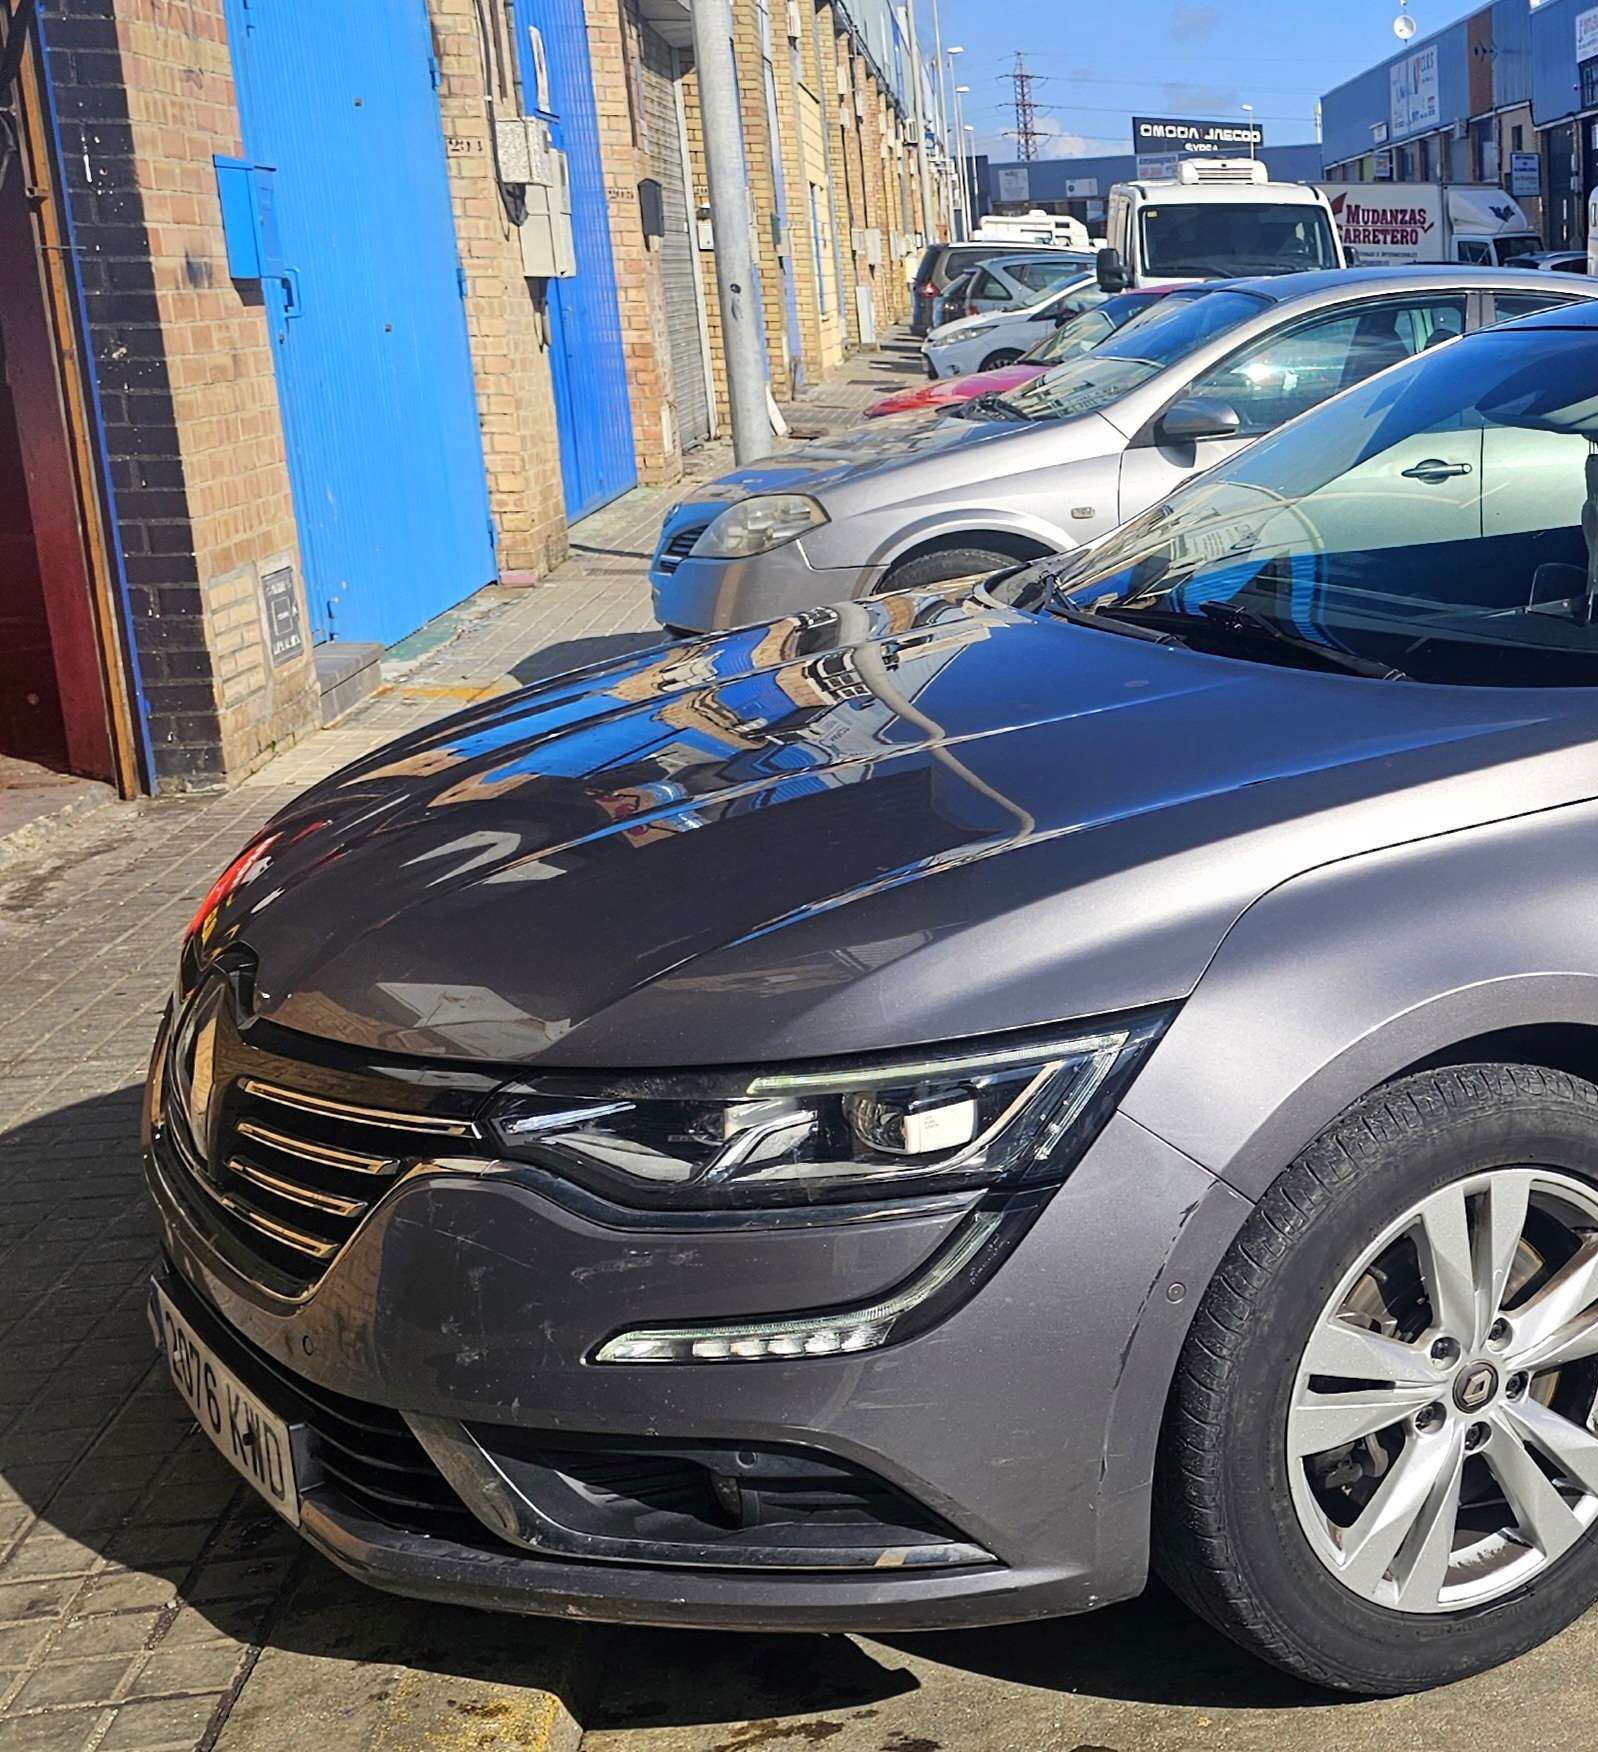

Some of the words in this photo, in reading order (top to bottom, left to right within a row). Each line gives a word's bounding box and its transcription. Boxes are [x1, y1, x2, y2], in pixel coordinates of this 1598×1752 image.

[1140, 123, 1199, 140] OMODA
[1203, 128, 1261, 143] JAECOO
[1346, 204, 1427, 225] MUDANZAS
[165, 1311, 222, 1435] 2076
[226, 1383, 286, 1501] KWD
